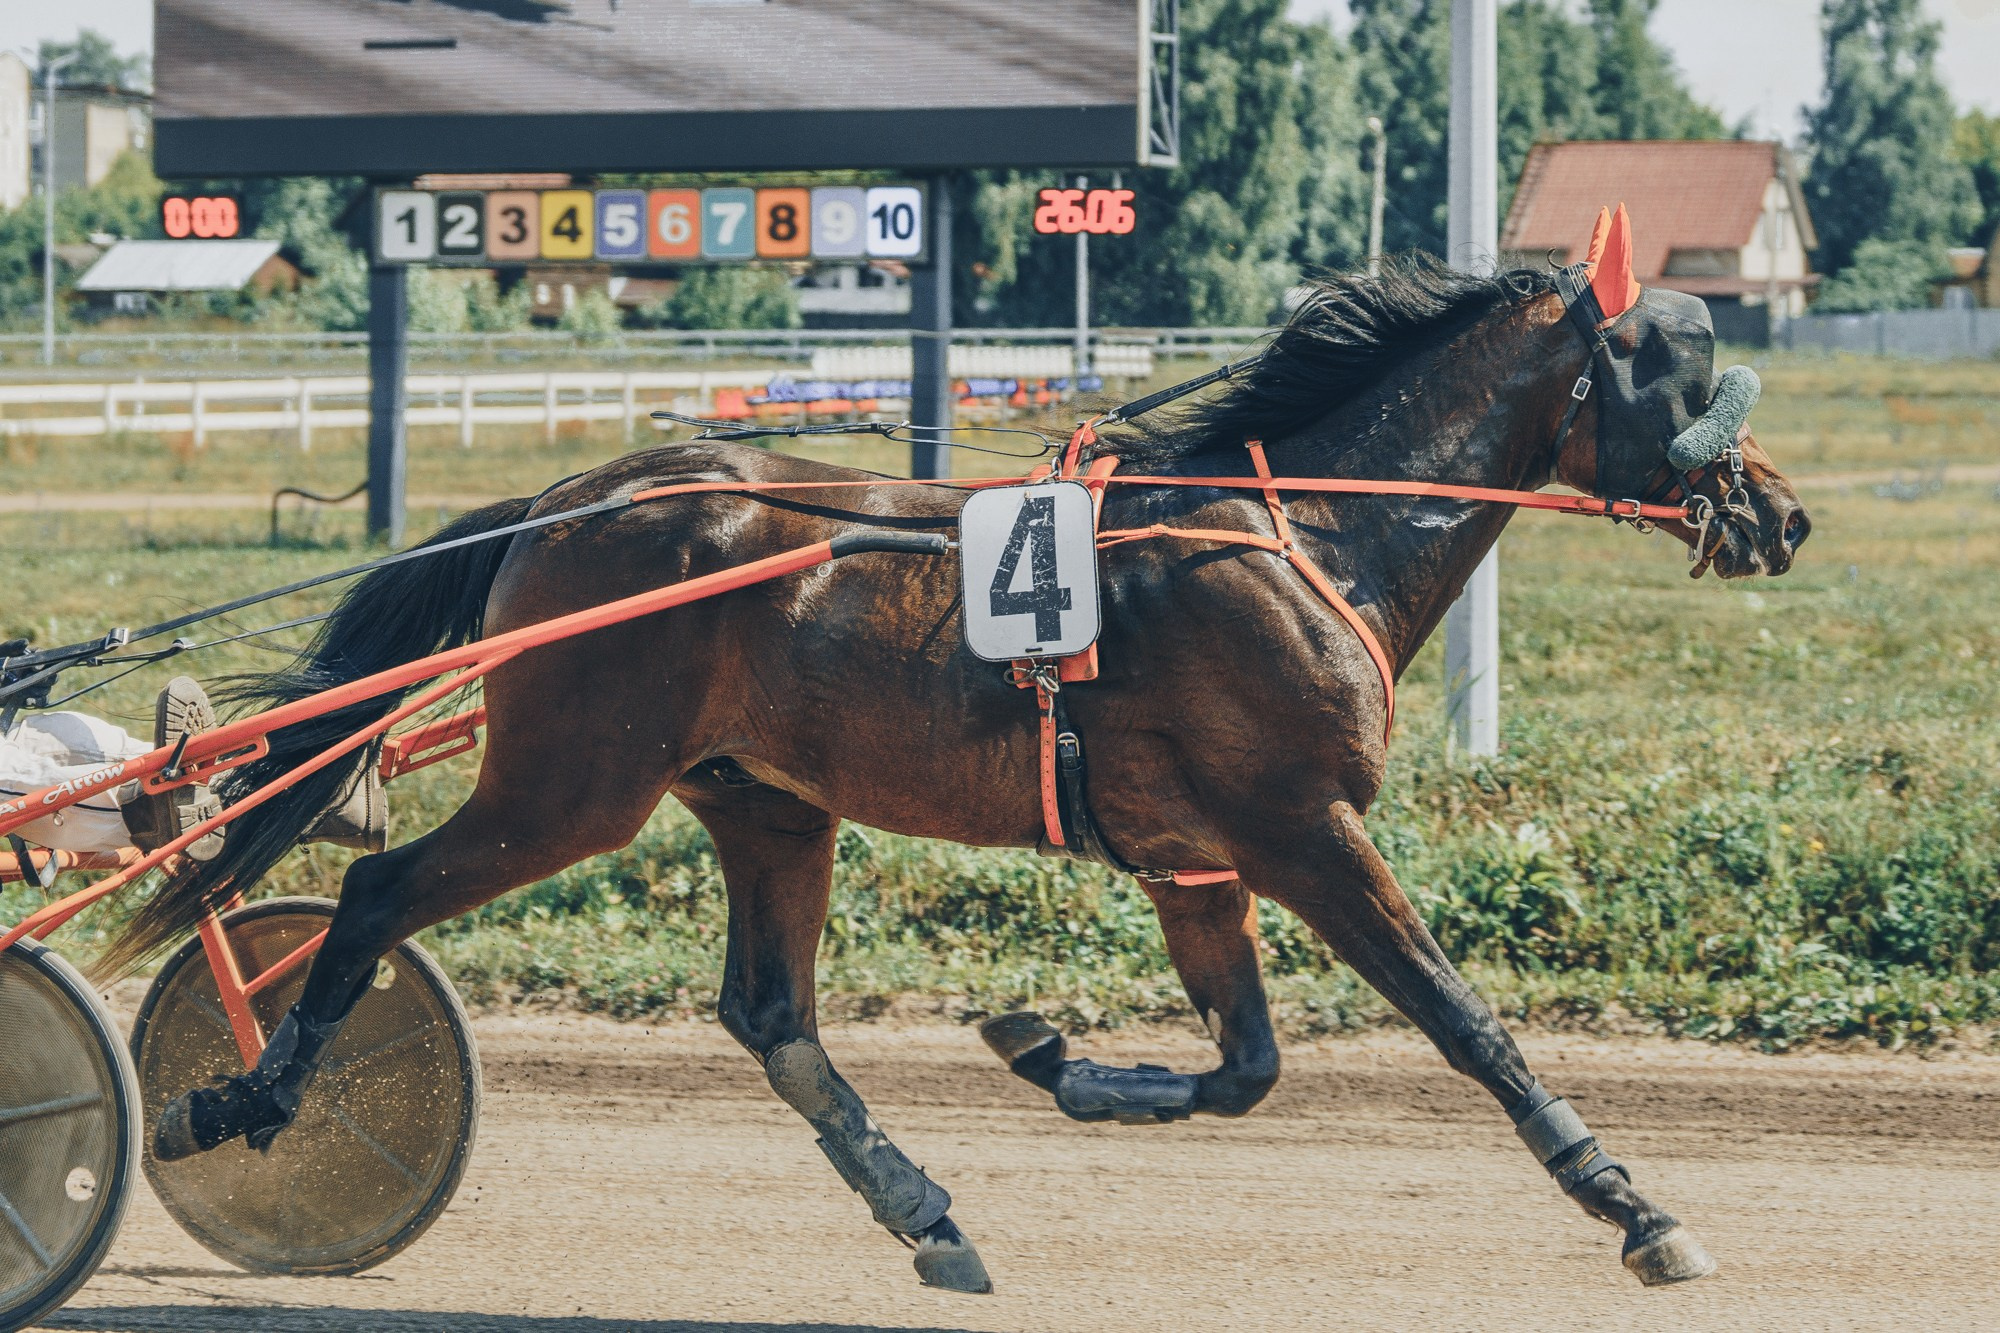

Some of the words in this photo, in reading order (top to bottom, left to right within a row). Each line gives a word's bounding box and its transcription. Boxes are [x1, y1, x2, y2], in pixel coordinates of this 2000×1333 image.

[396, 206, 416, 243] 1
[442, 204, 479, 247] 2
[500, 206, 527, 244] 3
[552, 205, 582, 243] 4
[603, 203, 639, 247] 5
[658, 203, 692, 245] 6
[710, 202, 746, 245] 7
[768, 204, 797, 241] 8
[821, 201, 856, 244] 9
[872, 203, 914, 239] 10
[990, 496, 1072, 642] 4
[43, 763, 125, 804] Arrow
